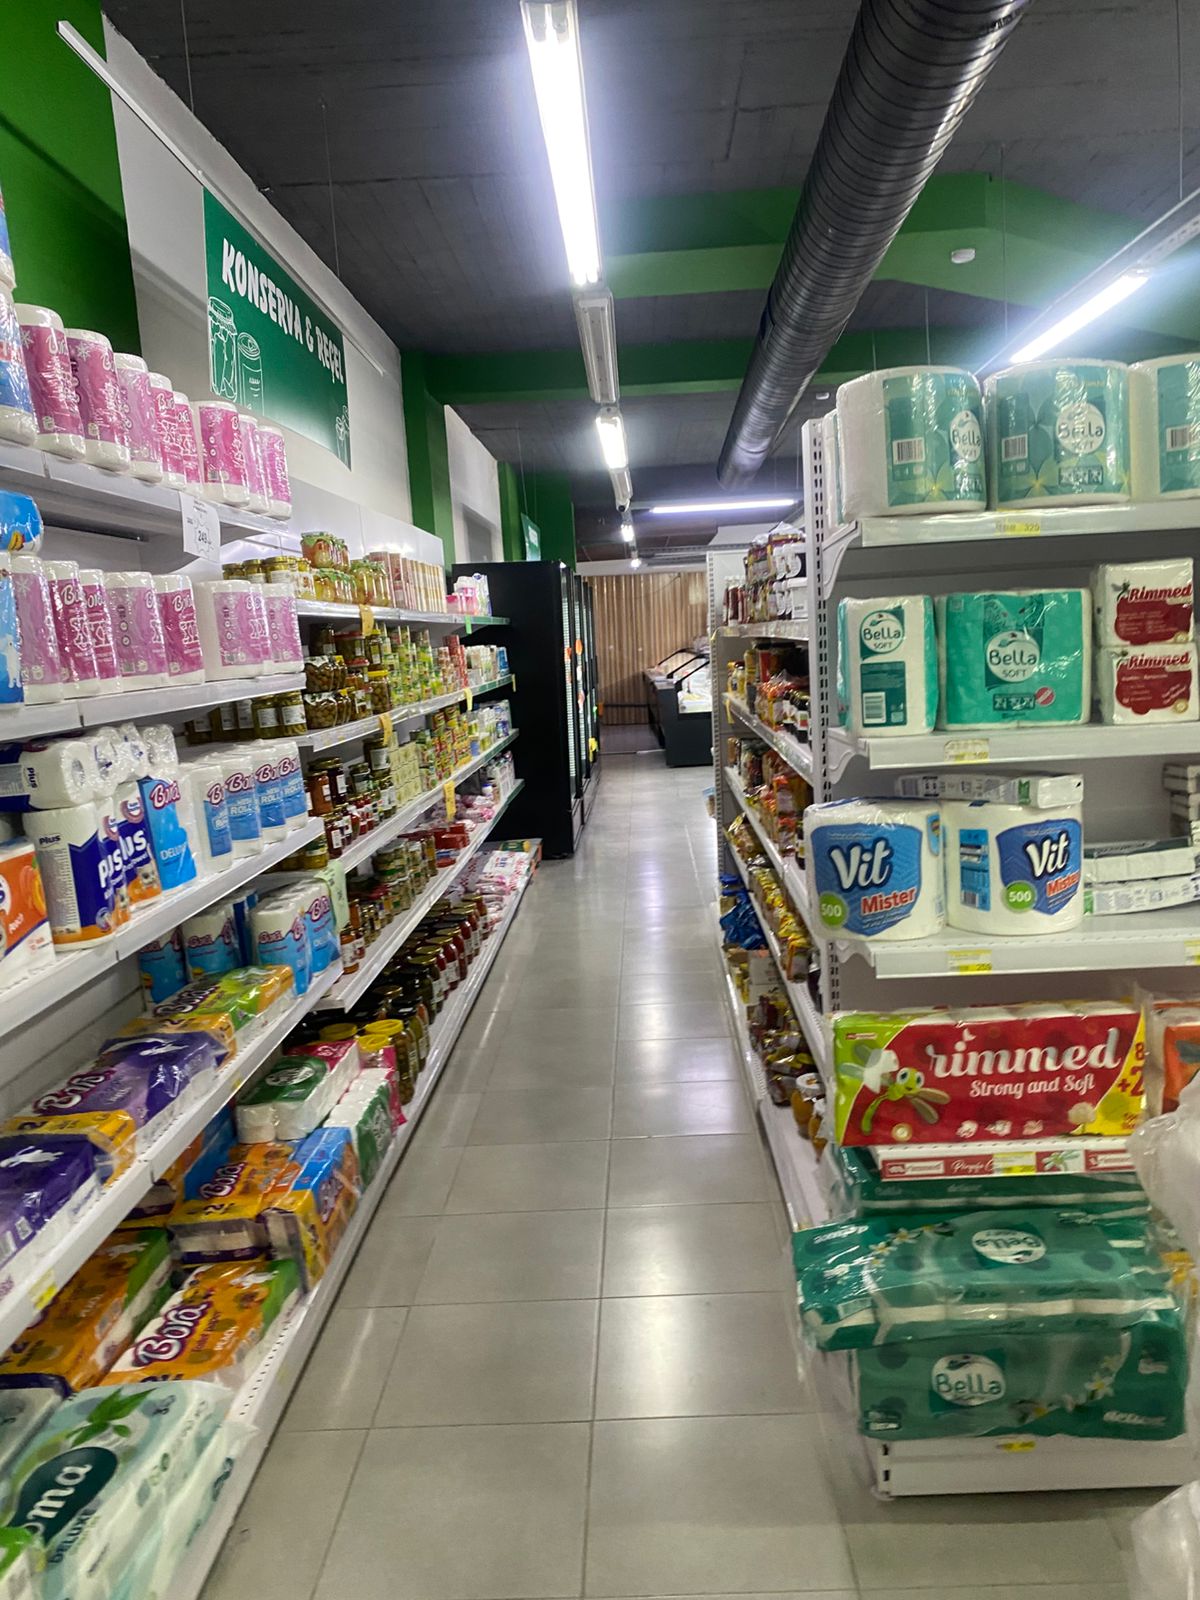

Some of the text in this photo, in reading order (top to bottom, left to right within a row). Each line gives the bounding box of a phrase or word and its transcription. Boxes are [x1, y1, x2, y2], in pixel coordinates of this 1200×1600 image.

[222, 237, 304, 345] KONSERVA
[306, 315, 314, 353] &
[1127, 583, 1193, 603] Rimmed
[863, 627, 901, 641] Bella
[989, 649, 1037, 666] Bella
[1126, 652, 1191, 669] Rimmed
[1002, 669, 1027, 678] SOFT
[830, 839, 891, 890] Vit
[1026, 832, 1069, 878] Vit
[861, 885, 918, 917] Mister
[1008, 890, 1032, 902] 500
[821, 903, 843, 918] 500
[927, 1027, 1122, 1079] rimmed
[970, 1080, 1024, 1099] Strong
[1028, 1077, 1060, 1094] and
[1063, 1073, 1095, 1096] Soft
[137, 1301, 211, 1364] Bora
[935, 1373, 1001, 1396] Bella
